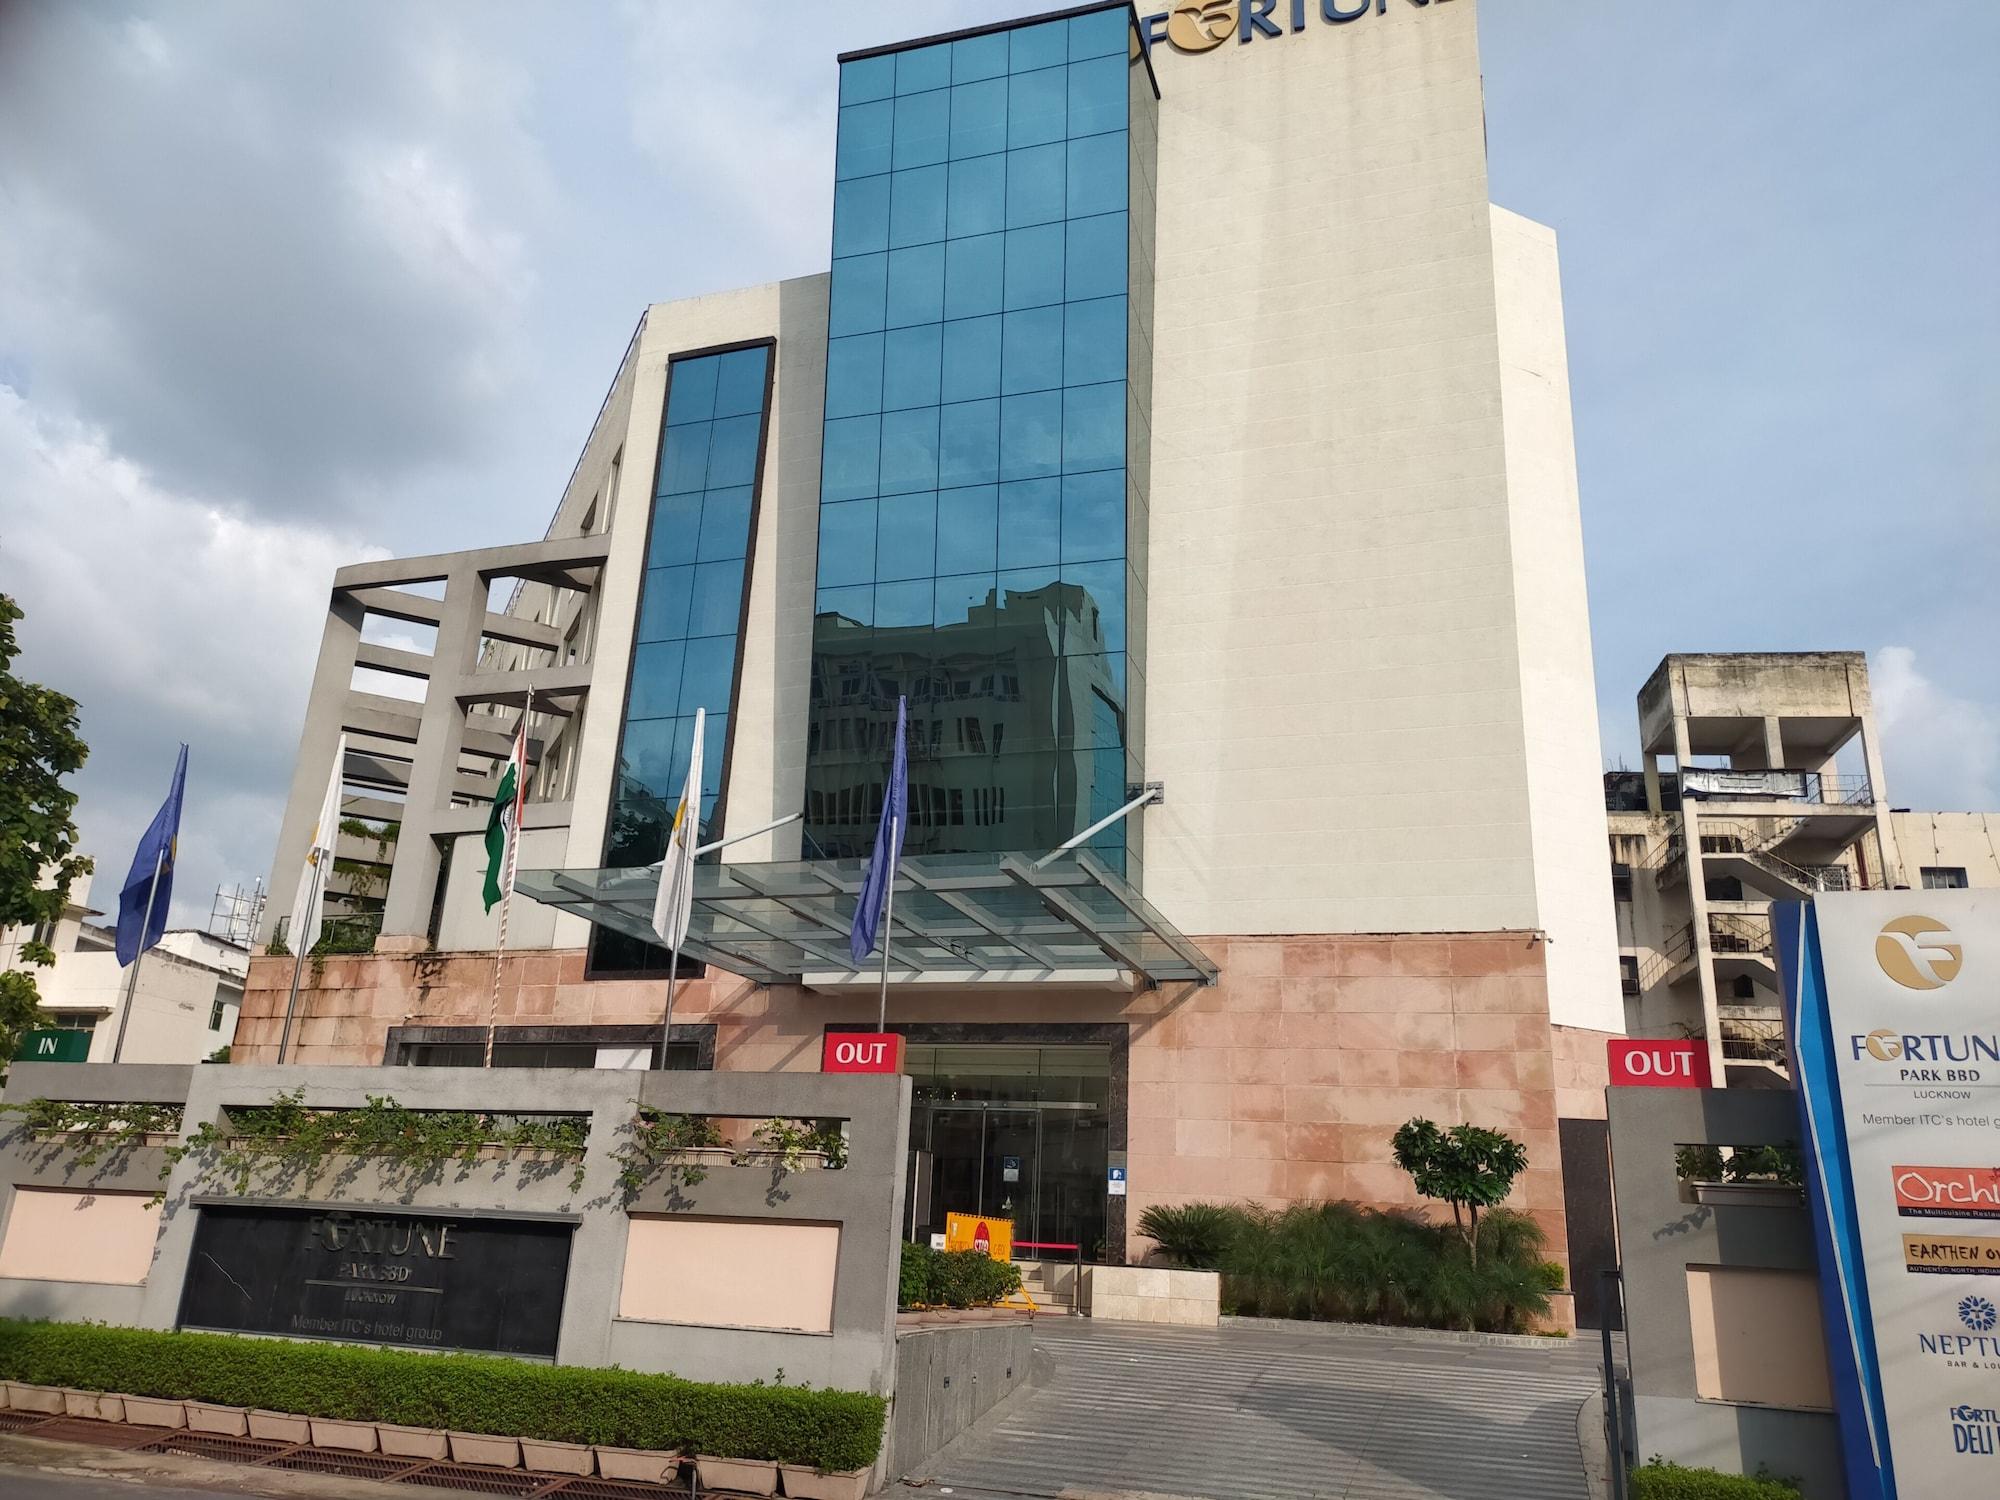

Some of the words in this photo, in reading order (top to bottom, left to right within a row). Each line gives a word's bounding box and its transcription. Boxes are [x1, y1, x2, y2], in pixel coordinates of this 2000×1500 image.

[38, 1037, 58, 1054] IN
[835, 1042, 887, 1064] OUT
[1624, 1050, 1695, 1077] OUT
[1900, 1069, 1941, 1081] PARK
[1946, 1069, 1980, 1081] BBD
[1914, 1090, 1971, 1099] LUCKNOW
[1863, 1113, 1915, 1125] Member
[1920, 1114, 1953, 1126] ITC's
[1957, 1115, 1989, 1127] hotel
[1925, 1209, 1970, 1217] Multicuisine
[305, 1211, 457, 1259] FORTUNE
[1909, 1243, 1979, 1260] EARTHEN
[291, 1315, 339, 1331] Member
[341, 1318, 371, 1334] ITC's
[374, 1322, 403, 1337] hotel
[406, 1326, 443, 1342] group
[1947, 1360, 1967, 1368] BAR
[1953, 1423, 1993, 1455] DELI
